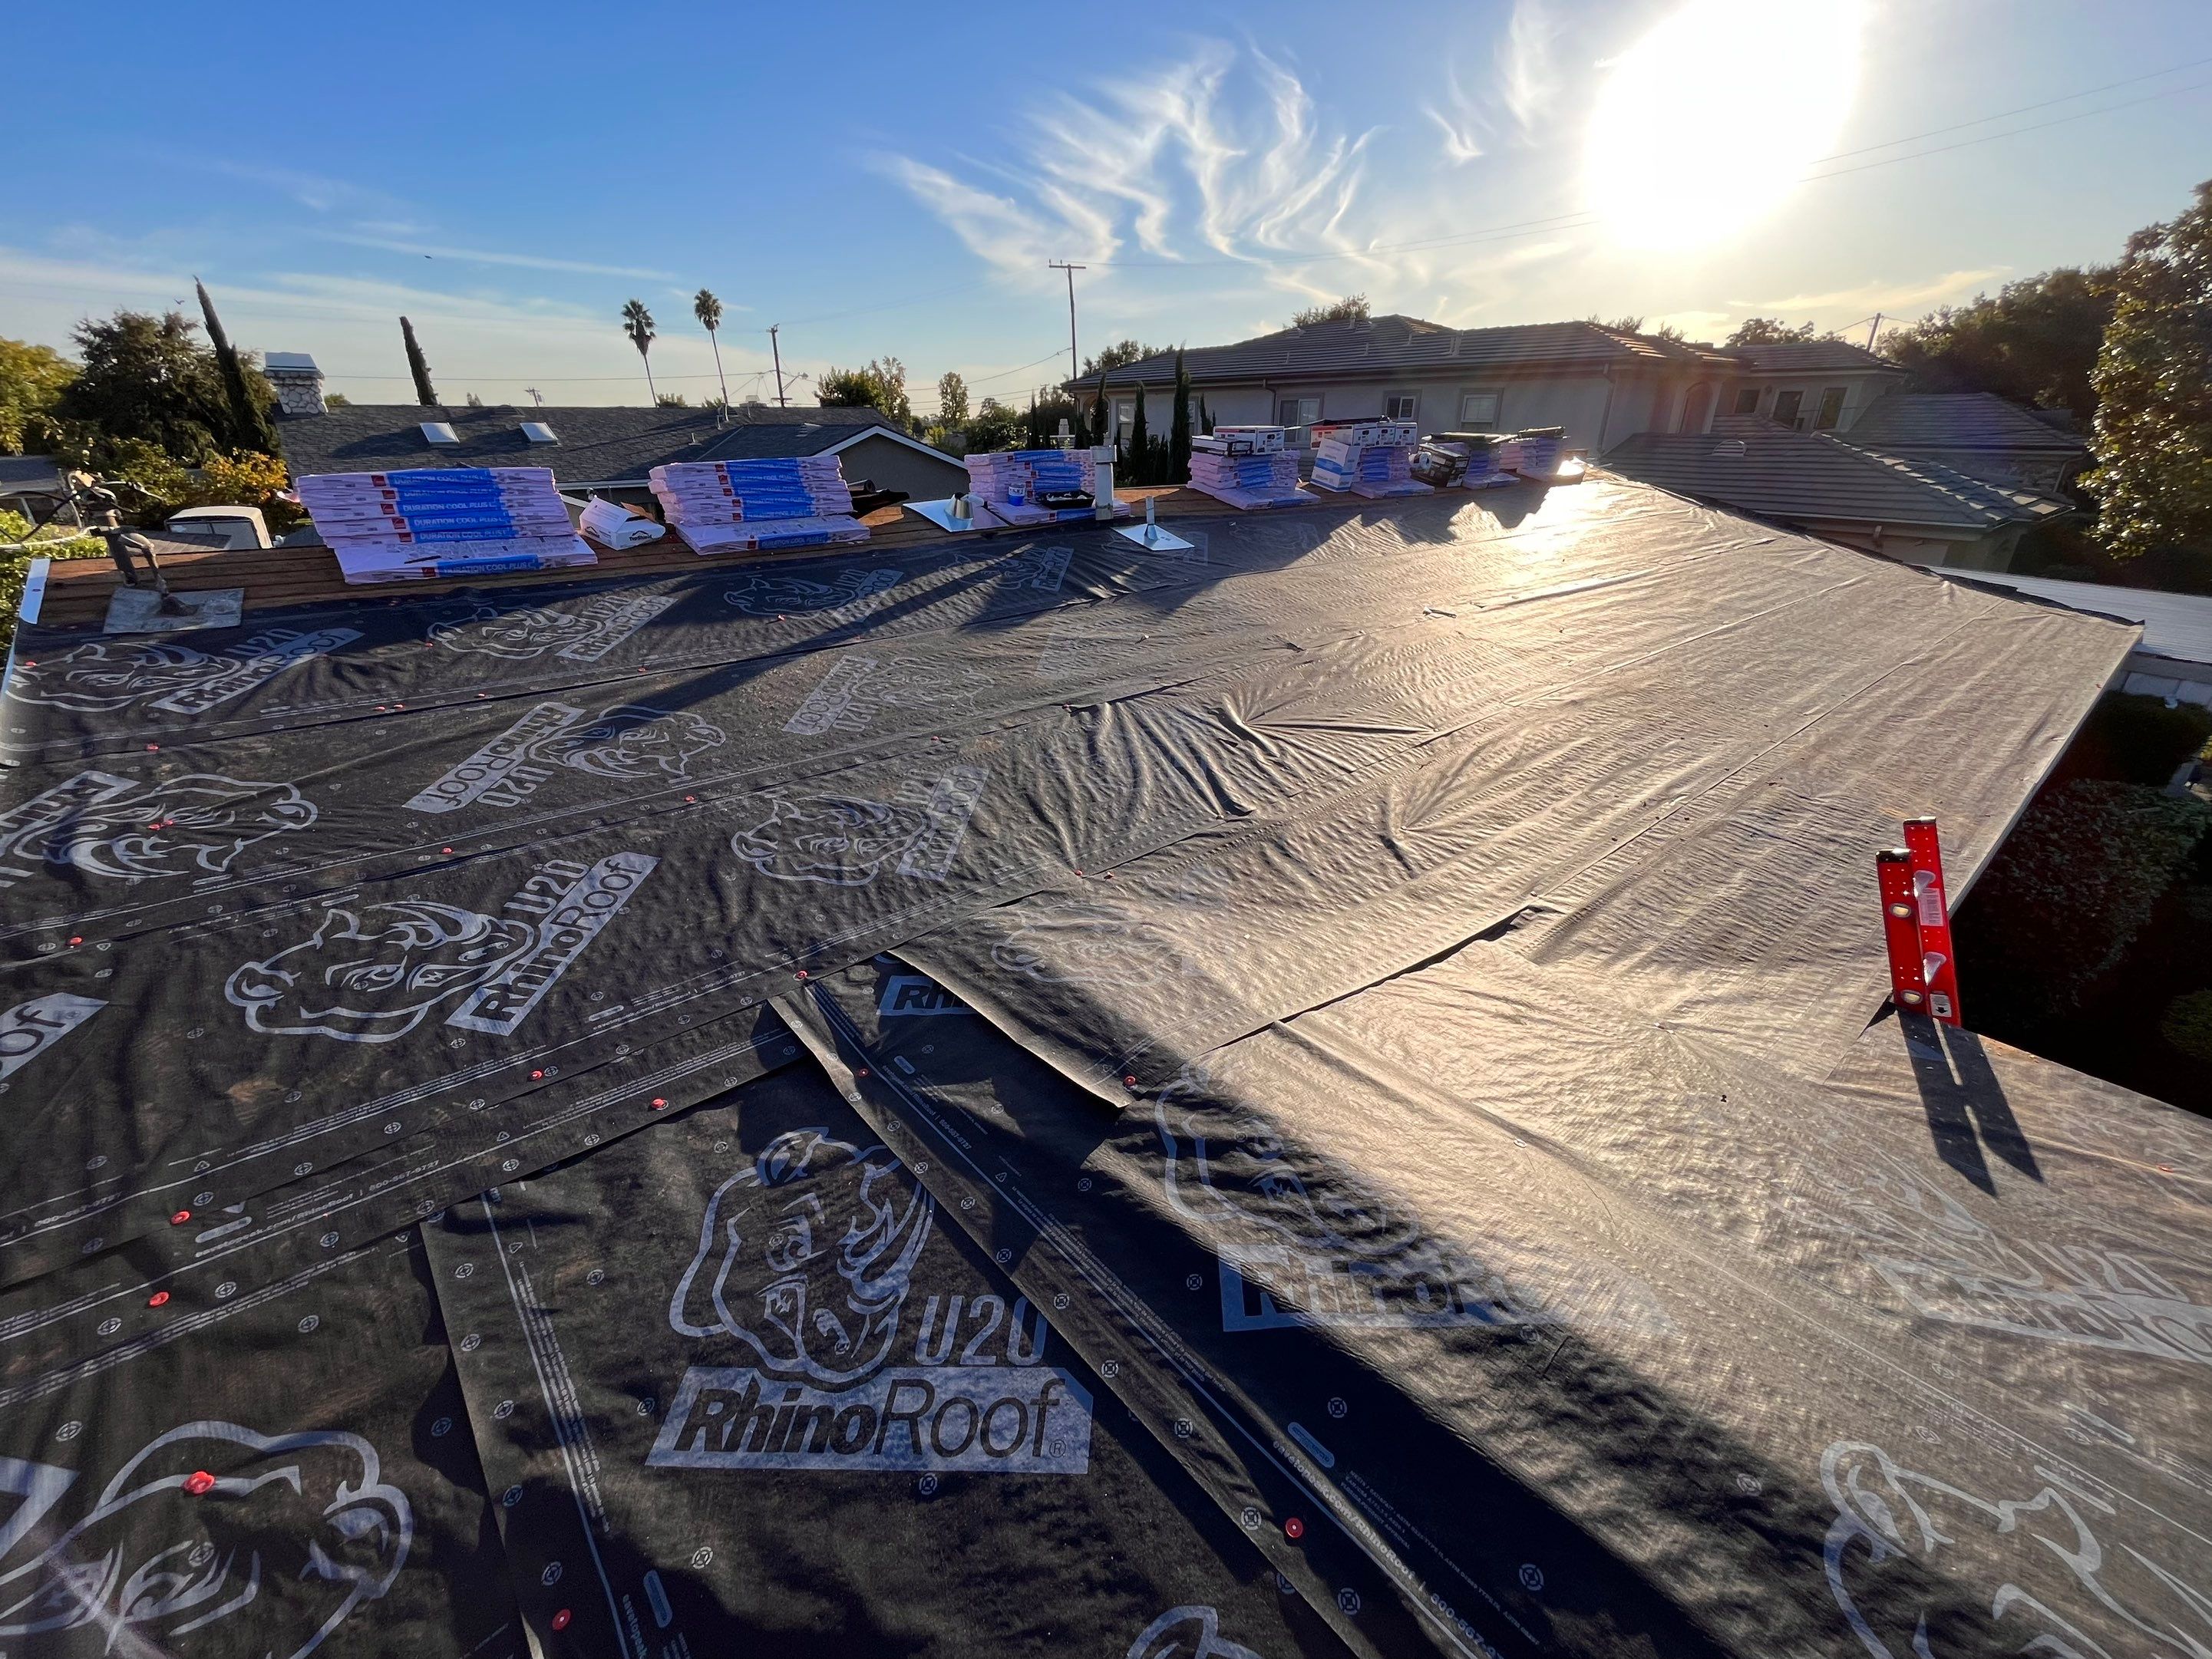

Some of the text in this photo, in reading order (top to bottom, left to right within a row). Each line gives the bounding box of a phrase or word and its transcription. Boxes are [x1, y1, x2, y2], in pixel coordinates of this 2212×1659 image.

[414, 518, 454, 526] DURATION
[486, 562, 507, 572] COOL
[169, 630, 346, 708] RhinoRoof
[224, 627, 305, 658] U20
[425, 705, 570, 807] RhinoRoof
[476, 765, 555, 808] U20
[503, 859, 591, 914] U20
[469, 859, 643, 1022] RhinoRoof
[915, 1294, 1048, 1366] U20
[672, 1377, 1067, 1459] RhinoRoof
